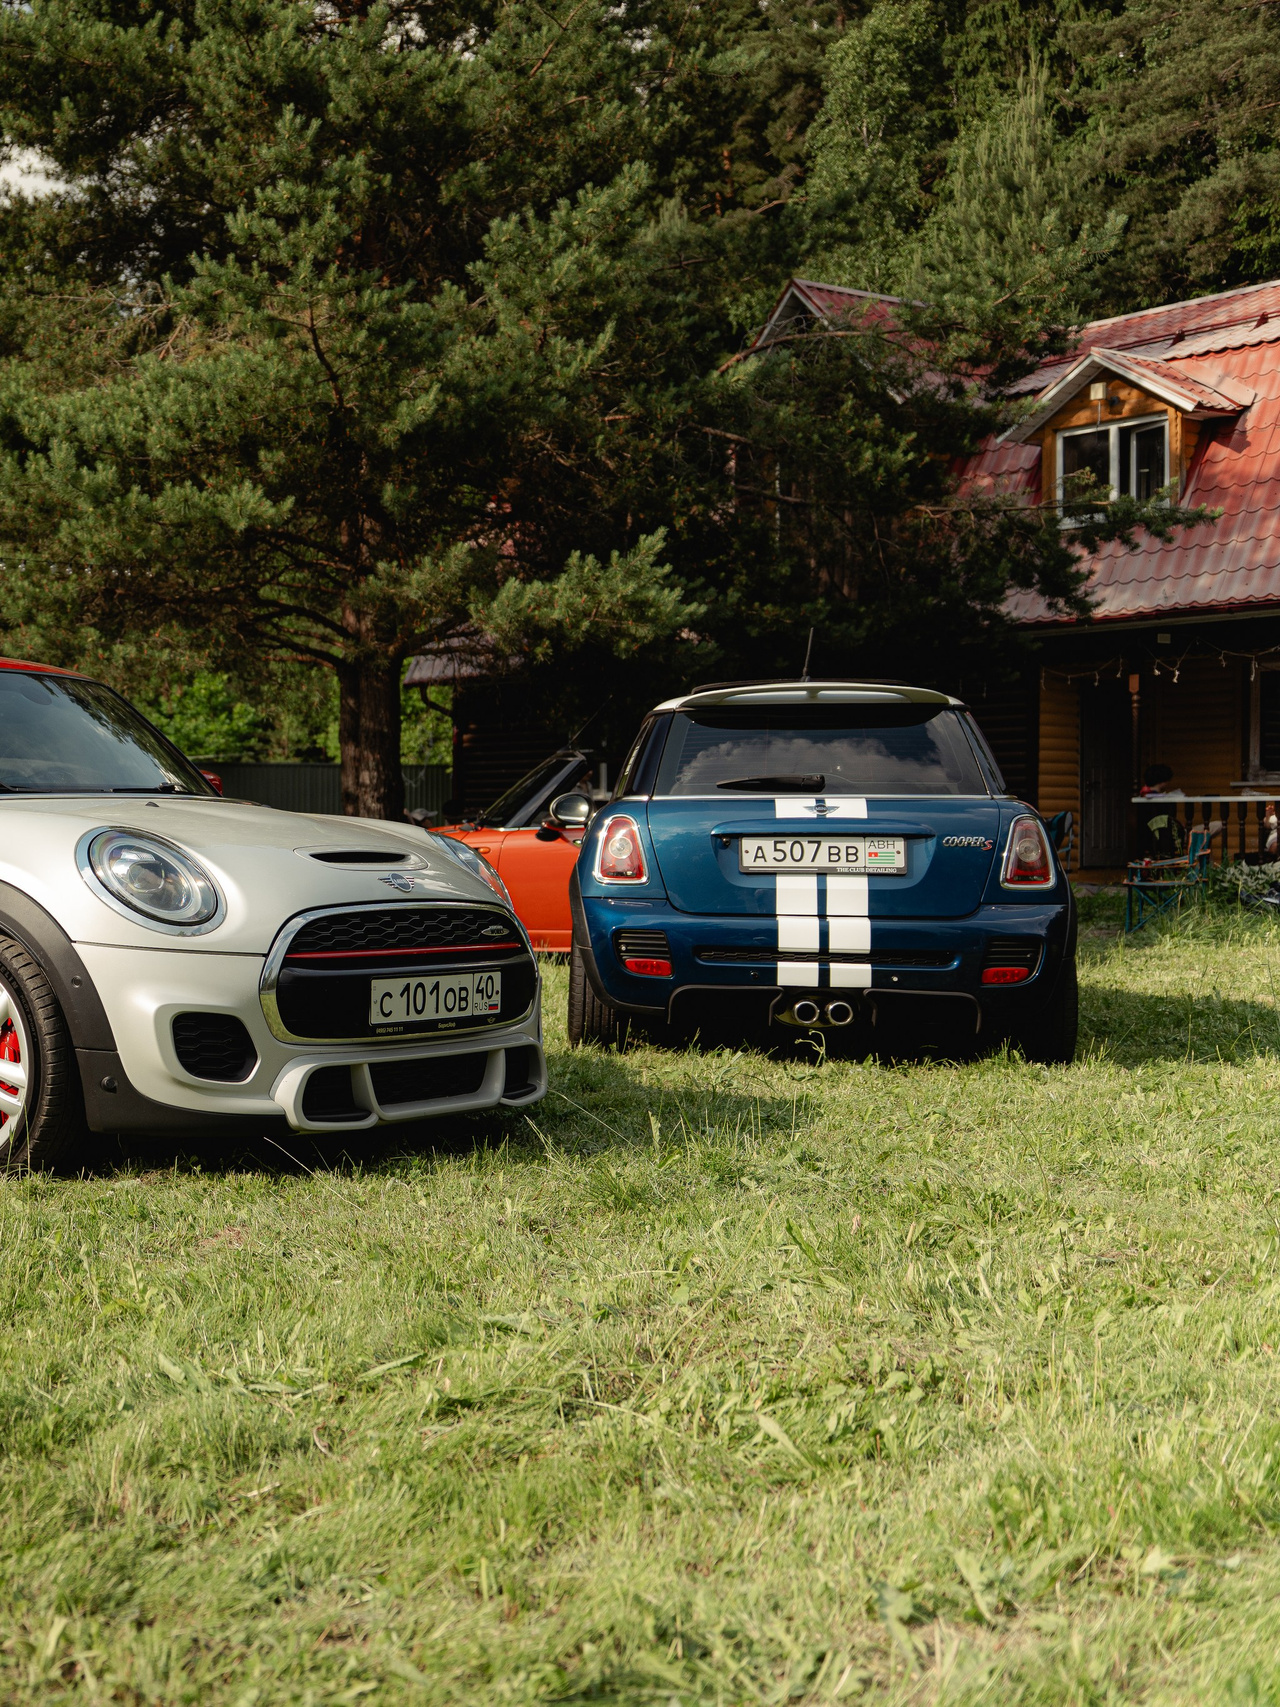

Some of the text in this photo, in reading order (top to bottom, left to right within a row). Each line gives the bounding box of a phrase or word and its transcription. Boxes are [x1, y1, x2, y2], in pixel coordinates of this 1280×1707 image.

[942, 836, 994, 851] COOPER S
[475, 974, 495, 1001] 40
[474, 1002, 488, 1011] RUS
